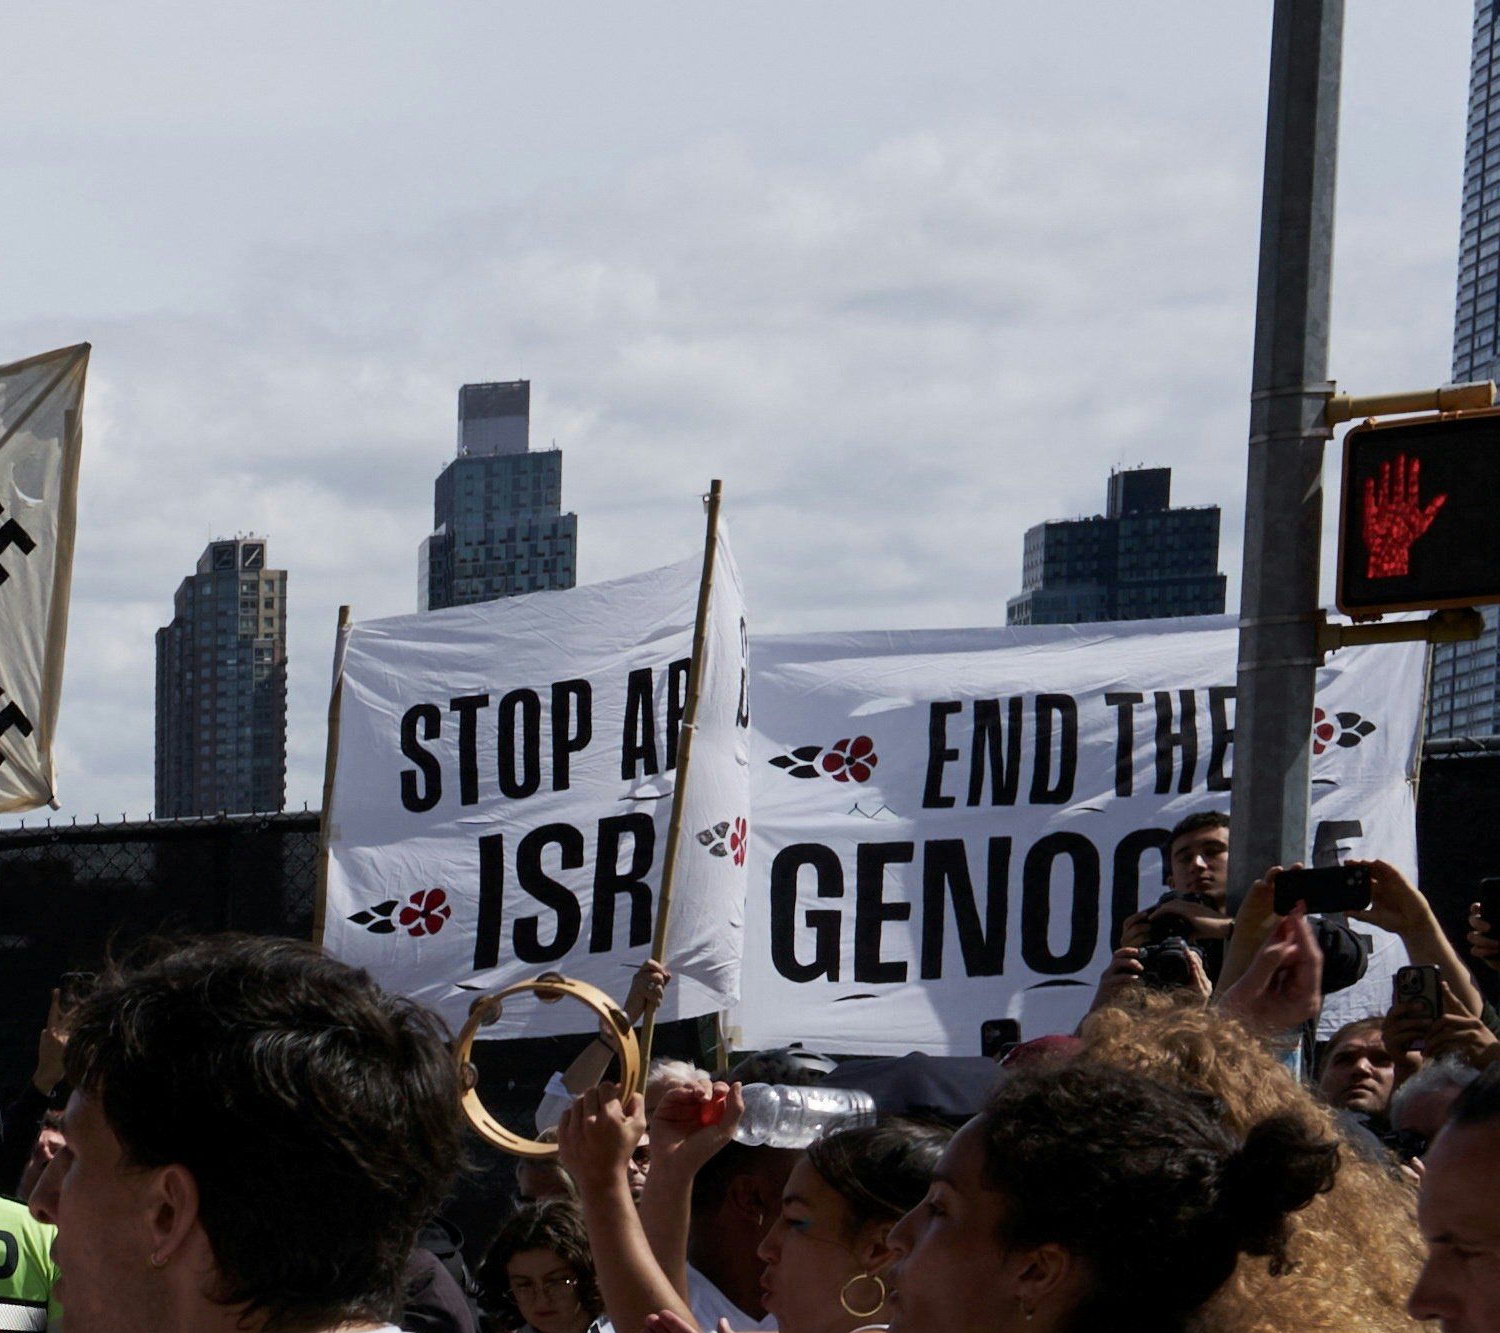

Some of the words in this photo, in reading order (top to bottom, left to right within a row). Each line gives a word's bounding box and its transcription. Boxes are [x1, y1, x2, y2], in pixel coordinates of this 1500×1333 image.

[399, 678, 592, 815] STOP
[922, 691, 1078, 811] END
[473, 811, 655, 973] ISR
